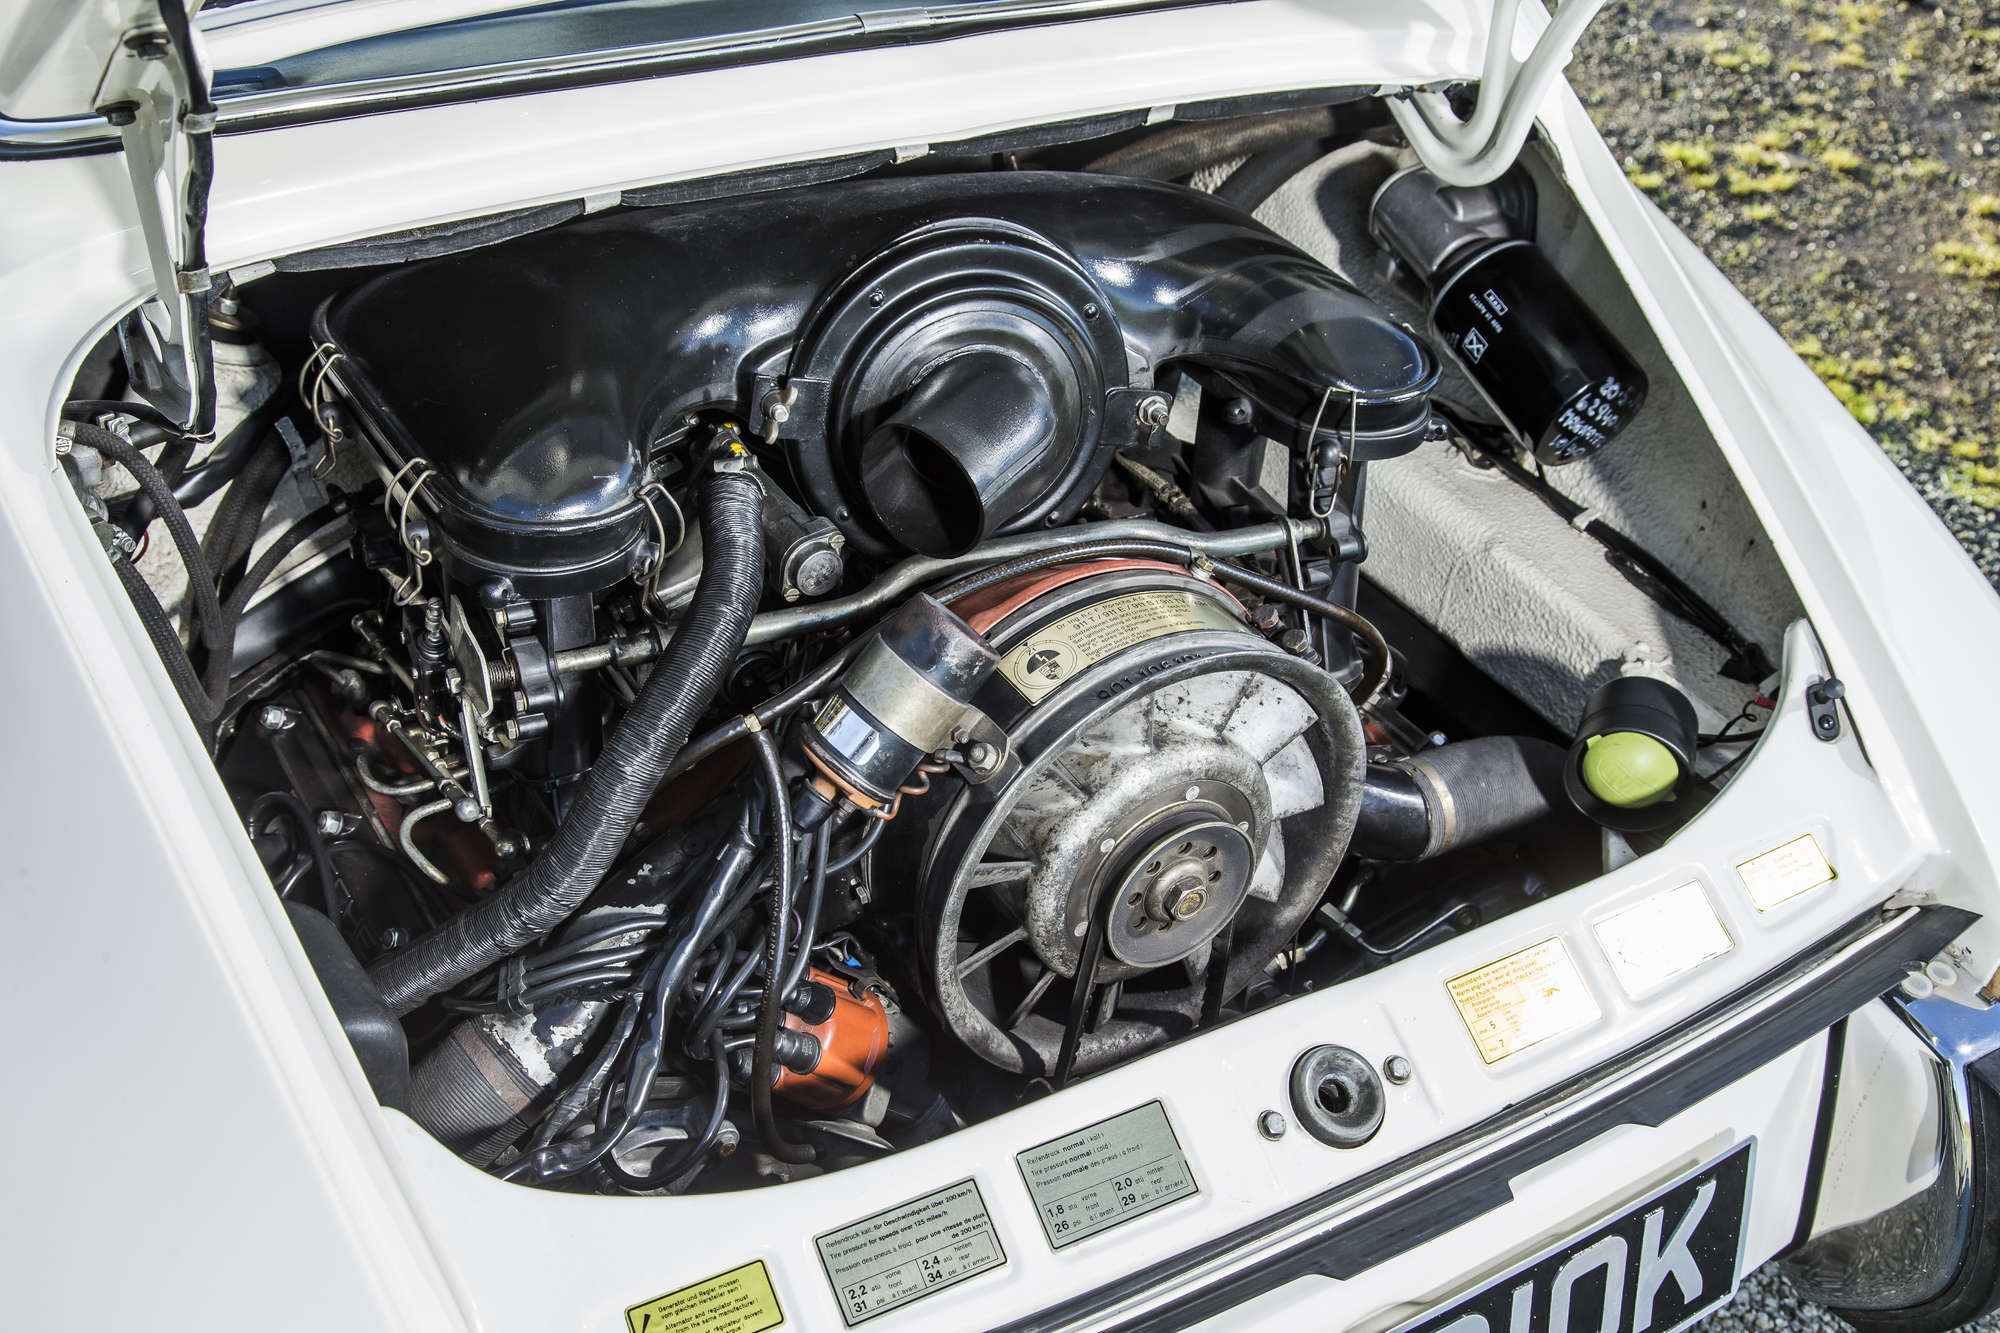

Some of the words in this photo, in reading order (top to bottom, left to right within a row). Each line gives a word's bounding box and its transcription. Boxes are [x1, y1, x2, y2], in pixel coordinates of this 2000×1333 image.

[1073, 619, 1088, 630] 911
[1102, 608, 1117, 617] 911
[1026, 1149, 1060, 1165] Reifendruck
[1061, 1139, 1086, 1152] normal
[1031, 1168, 1042, 1176] Tire
[1043, 1160, 1068, 1173] pressure
[1068, 1151, 1092, 1162] normal
[1035, 1175, 1060, 1188] Pression
[1061, 1165, 1088, 1179] normale
[1090, 1159, 1100, 1168] des
[1101, 1153, 1118, 1164] pneus
[1114, 1177, 1134, 1193] 2,0
[1146, 1165, 1164, 1176] hinten
[1150, 1177, 1164, 1186] rear
[1047, 1204, 1066, 1220] 1,8
[1081, 1191, 1098, 1201] vorne
[1085, 1202, 1100, 1211] front
[1121, 1193, 1136, 1206] 29
[825, 1233, 858, 1249] Reifendruck
[883, 1206, 930, 1227] Geschwindigkeit
[931, 1199, 944, 1208] über
[945, 1194, 958, 1203] 200
[957, 1188, 972, 1198] km/h
[961, 1227, 972, 1235] 200
[972, 1221, 988, 1231] km/h
[1053, 1220, 1070, 1233] 26
[1072, 1219, 1082, 1227] psi
[830, 1252, 842, 1260] Tire
[843, 1244, 868, 1256] pressure
[878, 1231, 898, 1242] speeds
[900, 1224, 912, 1233] over
[926, 1211, 948, 1223] miles/h
[835, 1262, 860, 1275] Pression
[915, 1235, 930, 1244] pour
[942, 1222, 962, 1233] vitesse
[972, 1212, 984, 1221] plus
[922, 1255, 940, 1272] 2,4
[954, 1241, 972, 1252] hinten
[959, 1253, 970, 1261] rear
[848, 1285, 868, 1301] 2,2
[885, 1270, 902, 1280] vorne
[888, 1279, 902, 1289] front
[927, 1270, 944, 1283] 34
[658, 1299, 684, 1312] Generator
[699, 1286, 716, 1298] Regler
[719, 1278, 740, 1289] müssen
[661, 1311, 672, 1319] vom
[675, 1303, 698, 1315] gleichen
[699, 1292, 726, 1305] Hersteller
[853, 1300, 868, 1313] 31
[876, 1297, 884, 1306] psi
[665, 1317, 692, 1331] Alternator
[695, 1311, 704, 1319] and
[707, 1302, 732, 1315] regulator
[734, 1294, 748, 1304] must
[675, 1325, 690, 1333] from
[702, 1315, 716, 1324] same
